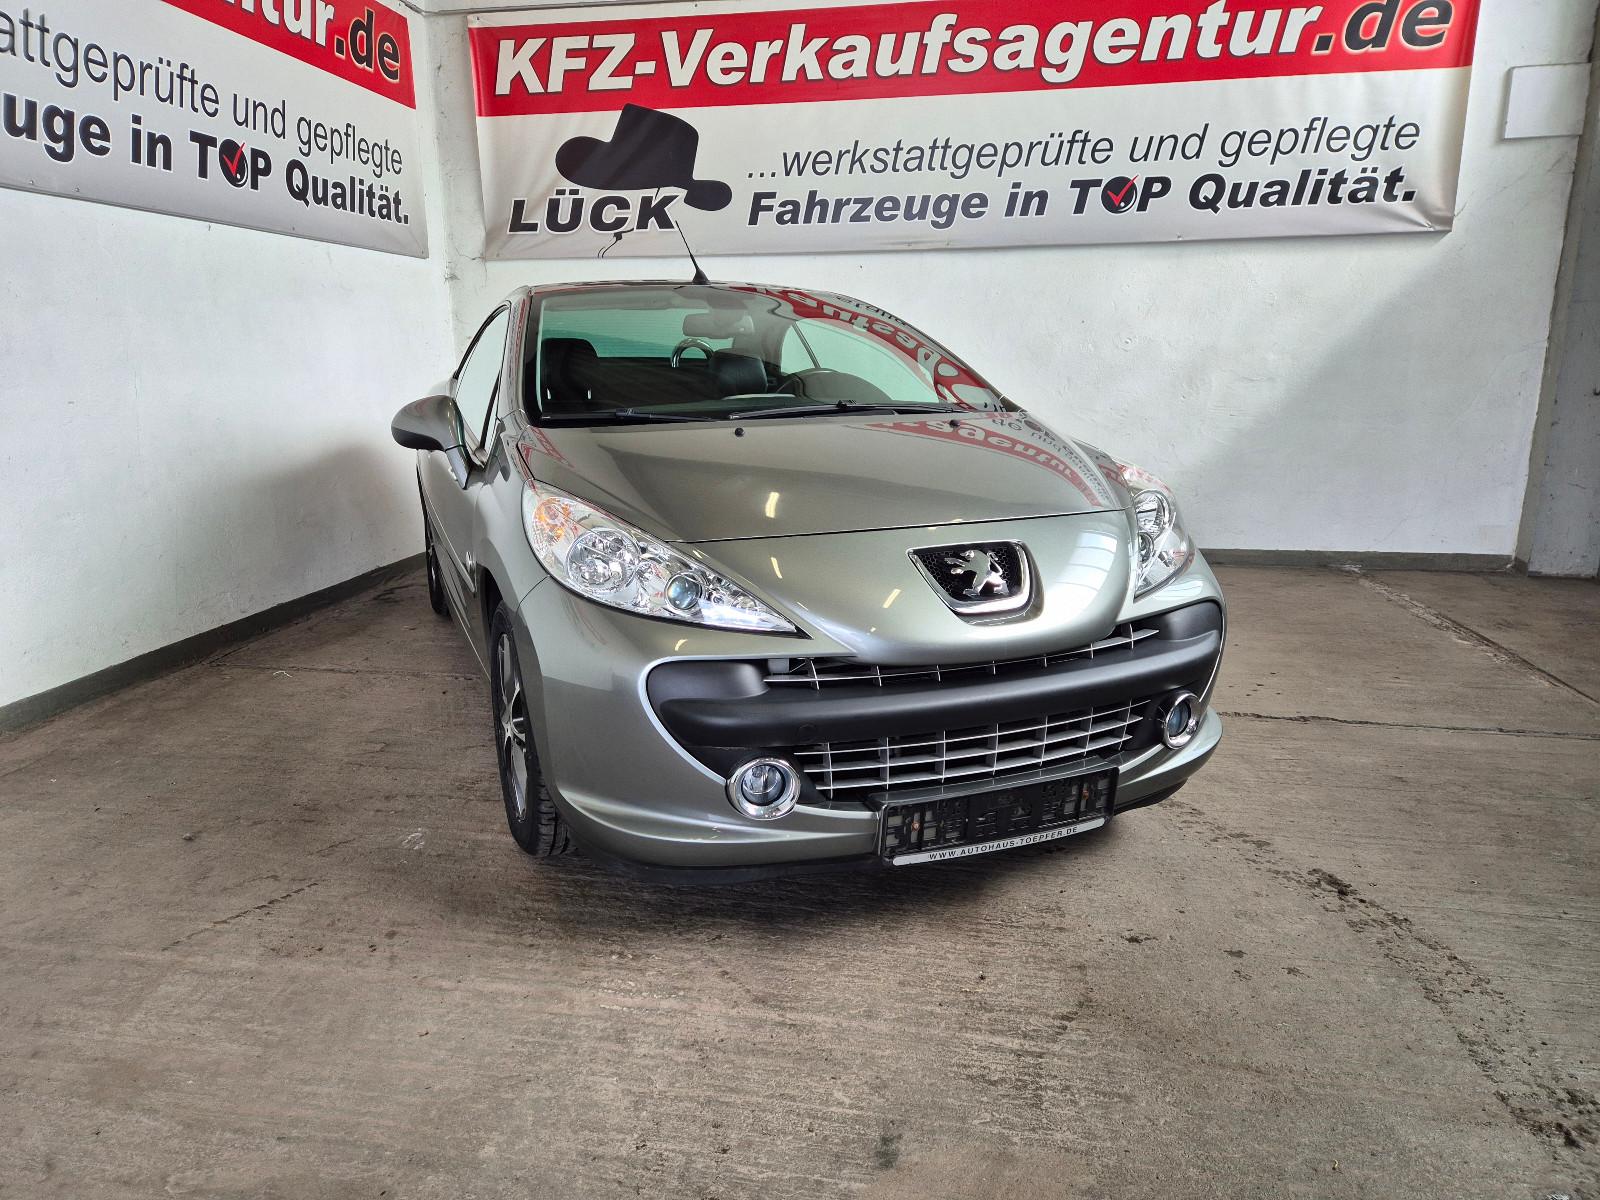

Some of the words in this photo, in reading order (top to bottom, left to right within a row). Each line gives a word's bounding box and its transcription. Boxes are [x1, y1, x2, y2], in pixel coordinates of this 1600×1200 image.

[495, 0, 1453, 96] KFZ-Verkaufsagentur.de
[233, 93, 286, 139] und
[297, 116, 403, 178] gepflegte
[747, 129, 1114, 180] ...werkstattgeprüfte
[1129, 123, 1210, 163] und
[1218, 114, 1420, 168] gepflegte
[130, 114, 172, 171] in
[285, 159, 410, 225] Qualität.
[747, 188, 989, 230] Fahrzeuge
[1003, 182, 1049, 218] in
[1188, 165, 1418, 214] Qualität.
[507, 188, 680, 234] LÜCK
[928, 826, 1078, 861] WWW.AUTOHAUS-TOEPFER.DE
